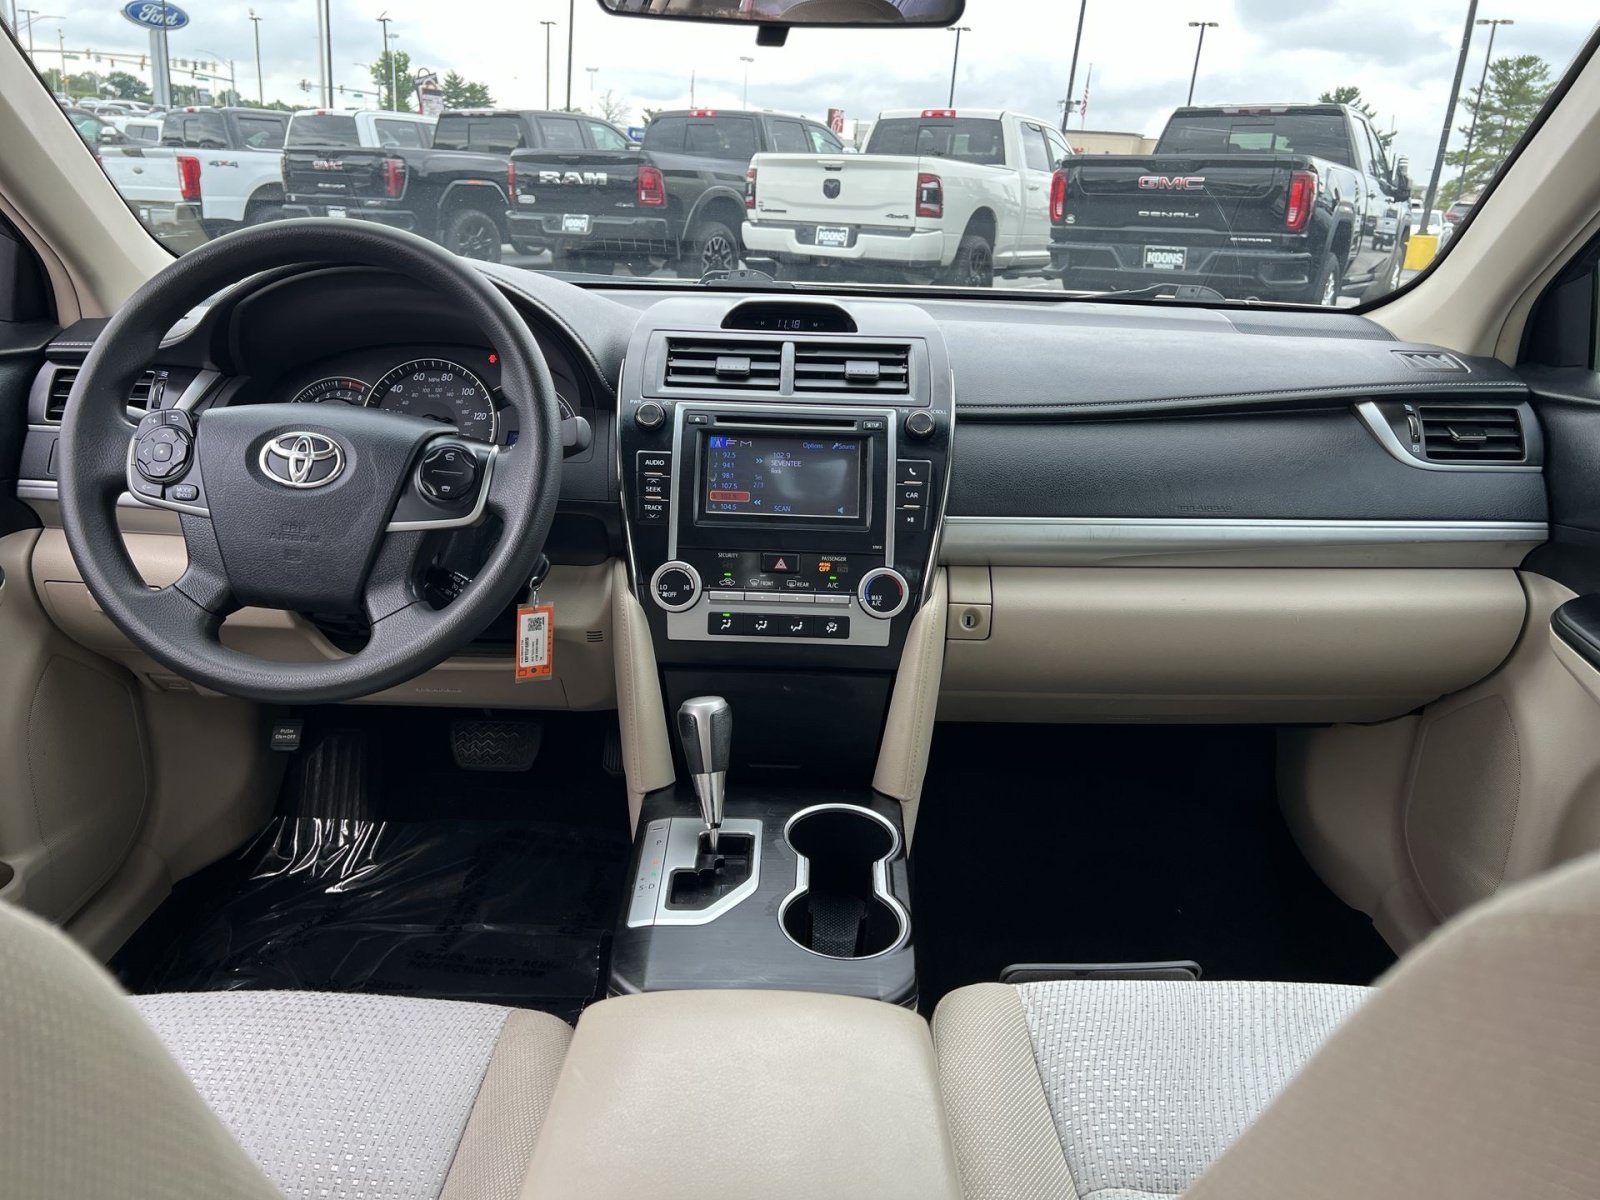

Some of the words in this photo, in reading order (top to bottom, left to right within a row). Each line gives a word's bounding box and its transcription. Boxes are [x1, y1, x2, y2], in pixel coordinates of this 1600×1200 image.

[138, 4, 178, 26] Ford
[312, 160, 343, 170] GMC
[539, 171, 607, 185] RAM
[1138, 176, 1206, 190] GMC
[1138, 210, 1199, 218] DENALI
[818, 230, 846, 243] KOONS
[1146, 251, 1183, 264] KOONS
[412, 372, 425, 381] 60
[440, 373, 453, 381] 80
[390, 384, 403, 393] 40
[461, 388, 475, 396] 100
[473, 412, 487, 420] 120
[497, 968, 546, 978] COVER
